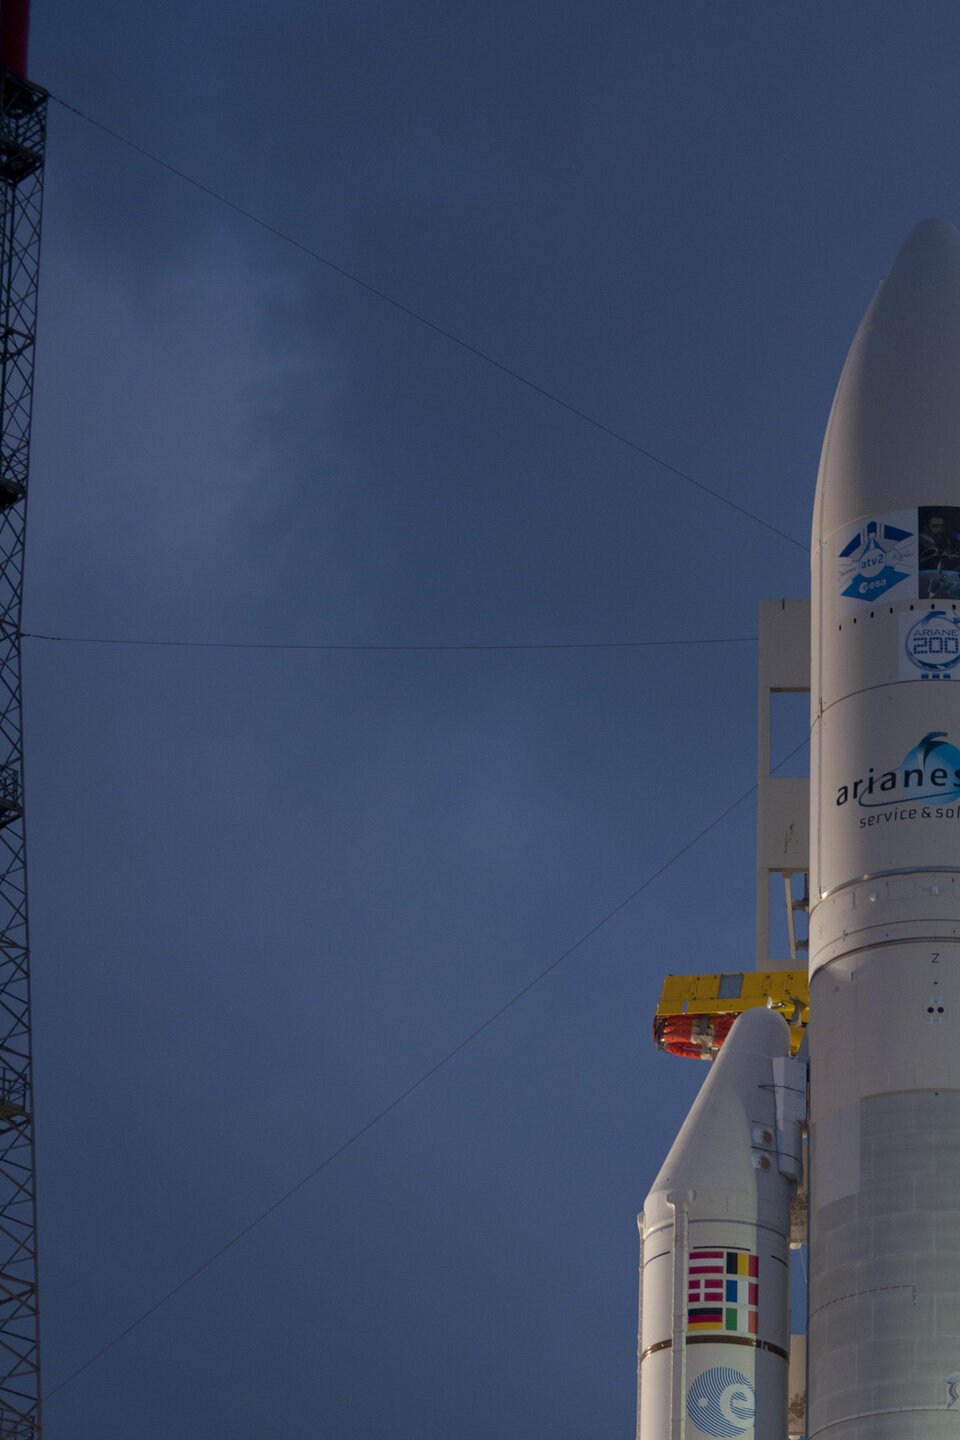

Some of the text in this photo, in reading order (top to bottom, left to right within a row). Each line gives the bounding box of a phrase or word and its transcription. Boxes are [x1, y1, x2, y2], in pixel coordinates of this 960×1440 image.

[861, 553, 884, 569] atv2
[913, 628, 960, 637] ARIANE
[913, 637, 959, 654] 200
[859, 807, 917, 829] service
[920, 806, 932, 819] &
[931, 952, 941, 964] Z
